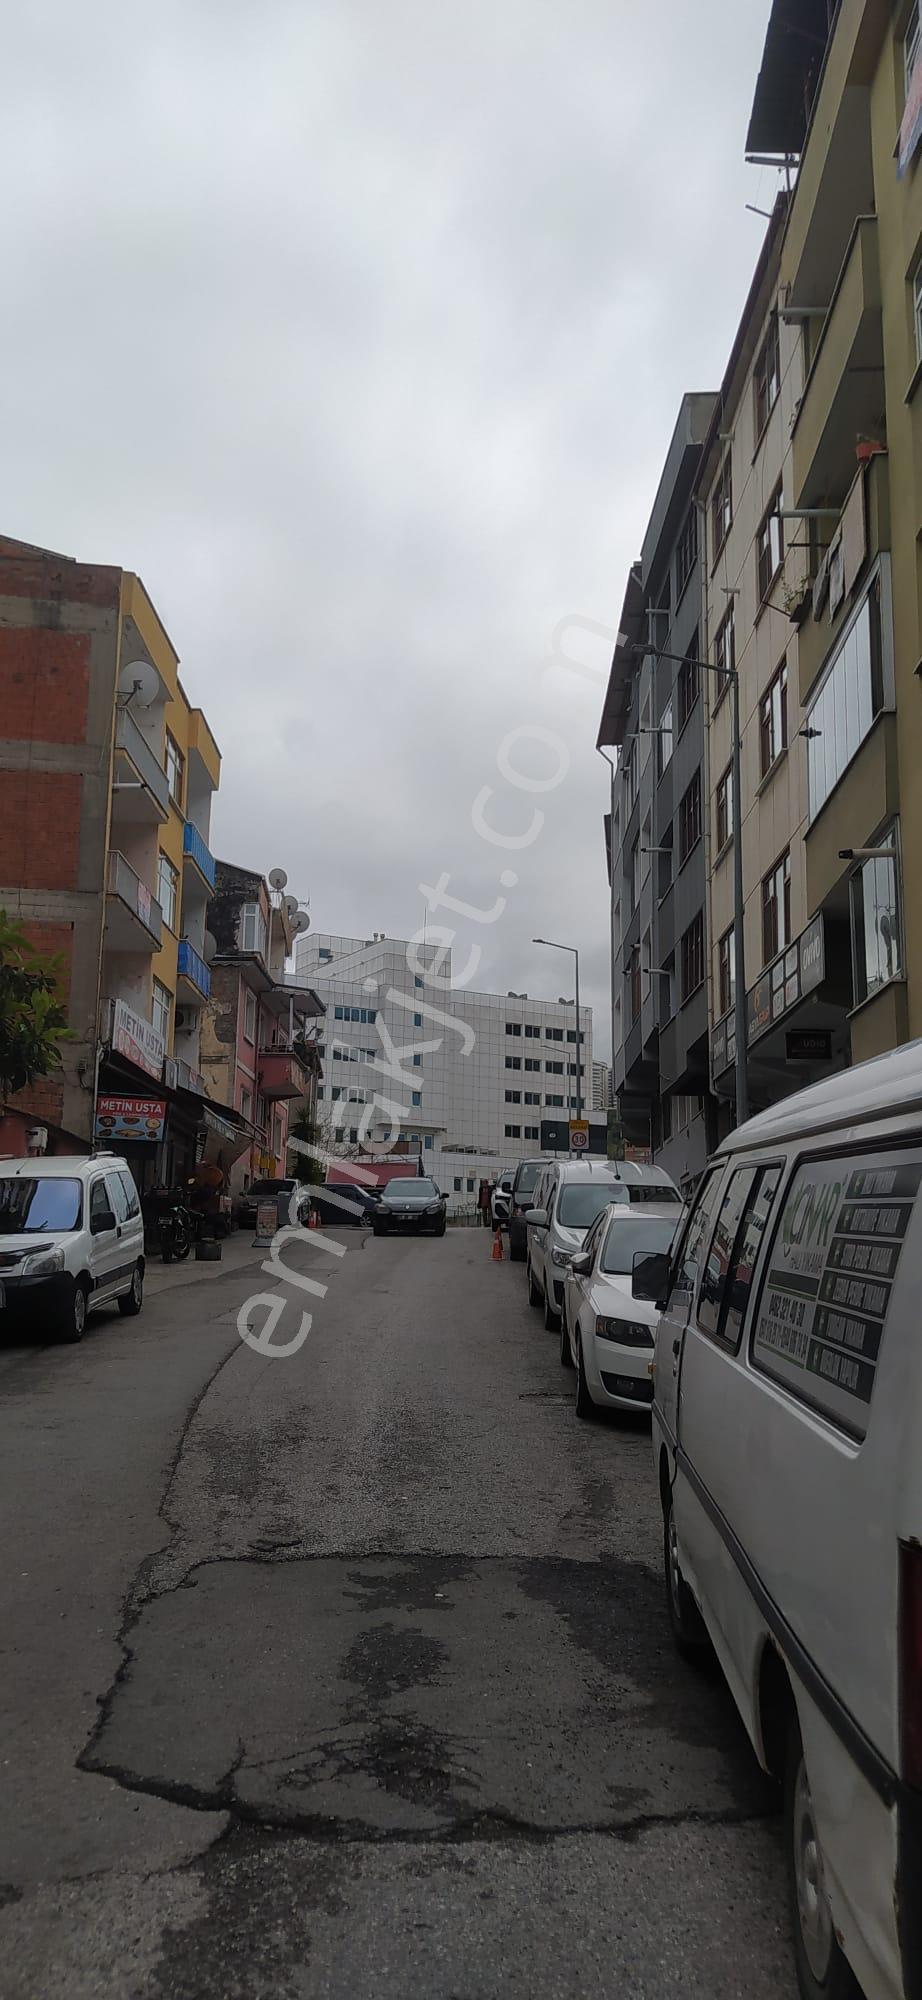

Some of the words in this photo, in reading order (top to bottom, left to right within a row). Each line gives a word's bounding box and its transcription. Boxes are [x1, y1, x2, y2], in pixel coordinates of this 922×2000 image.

[119, 1008, 145, 1042] METİN
[145, 1029, 163, 1058] USTA
[100, 1100, 132, 1112] METİN
[135, 1103, 162, 1113] USTA
[575, 1135, 584, 1143] 30
